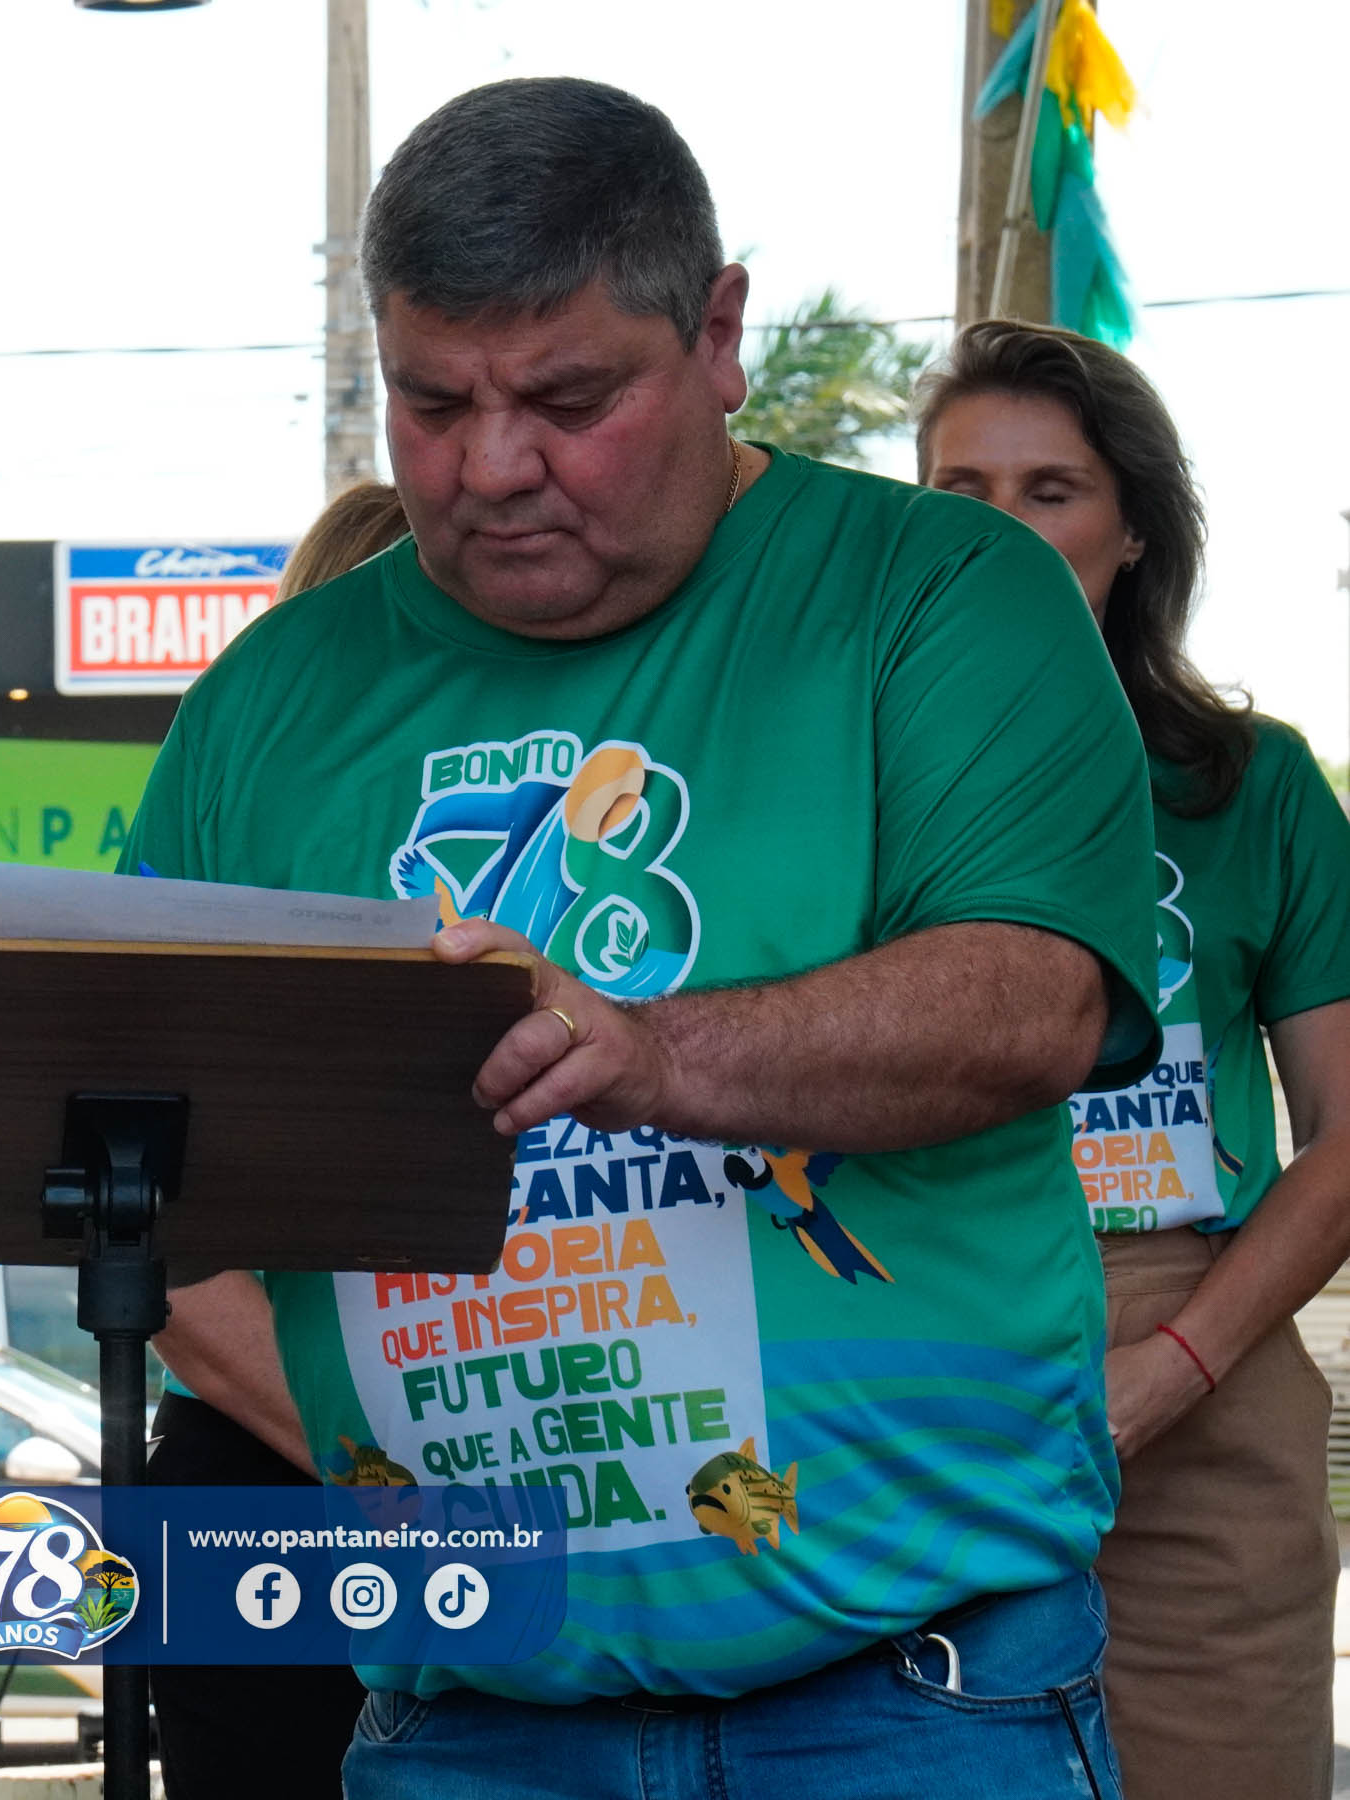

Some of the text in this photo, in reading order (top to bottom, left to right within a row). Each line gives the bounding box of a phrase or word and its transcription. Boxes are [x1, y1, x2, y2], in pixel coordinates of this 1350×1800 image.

[429, 737, 575, 794] BONITO
[1152, 1060, 1204, 1089] QUE
[382, 1274, 698, 1369] QUE INSPIRA,
[402, 1338, 642, 1422] FUTURO
[422, 1388, 731, 1481] QUE A GENTE
